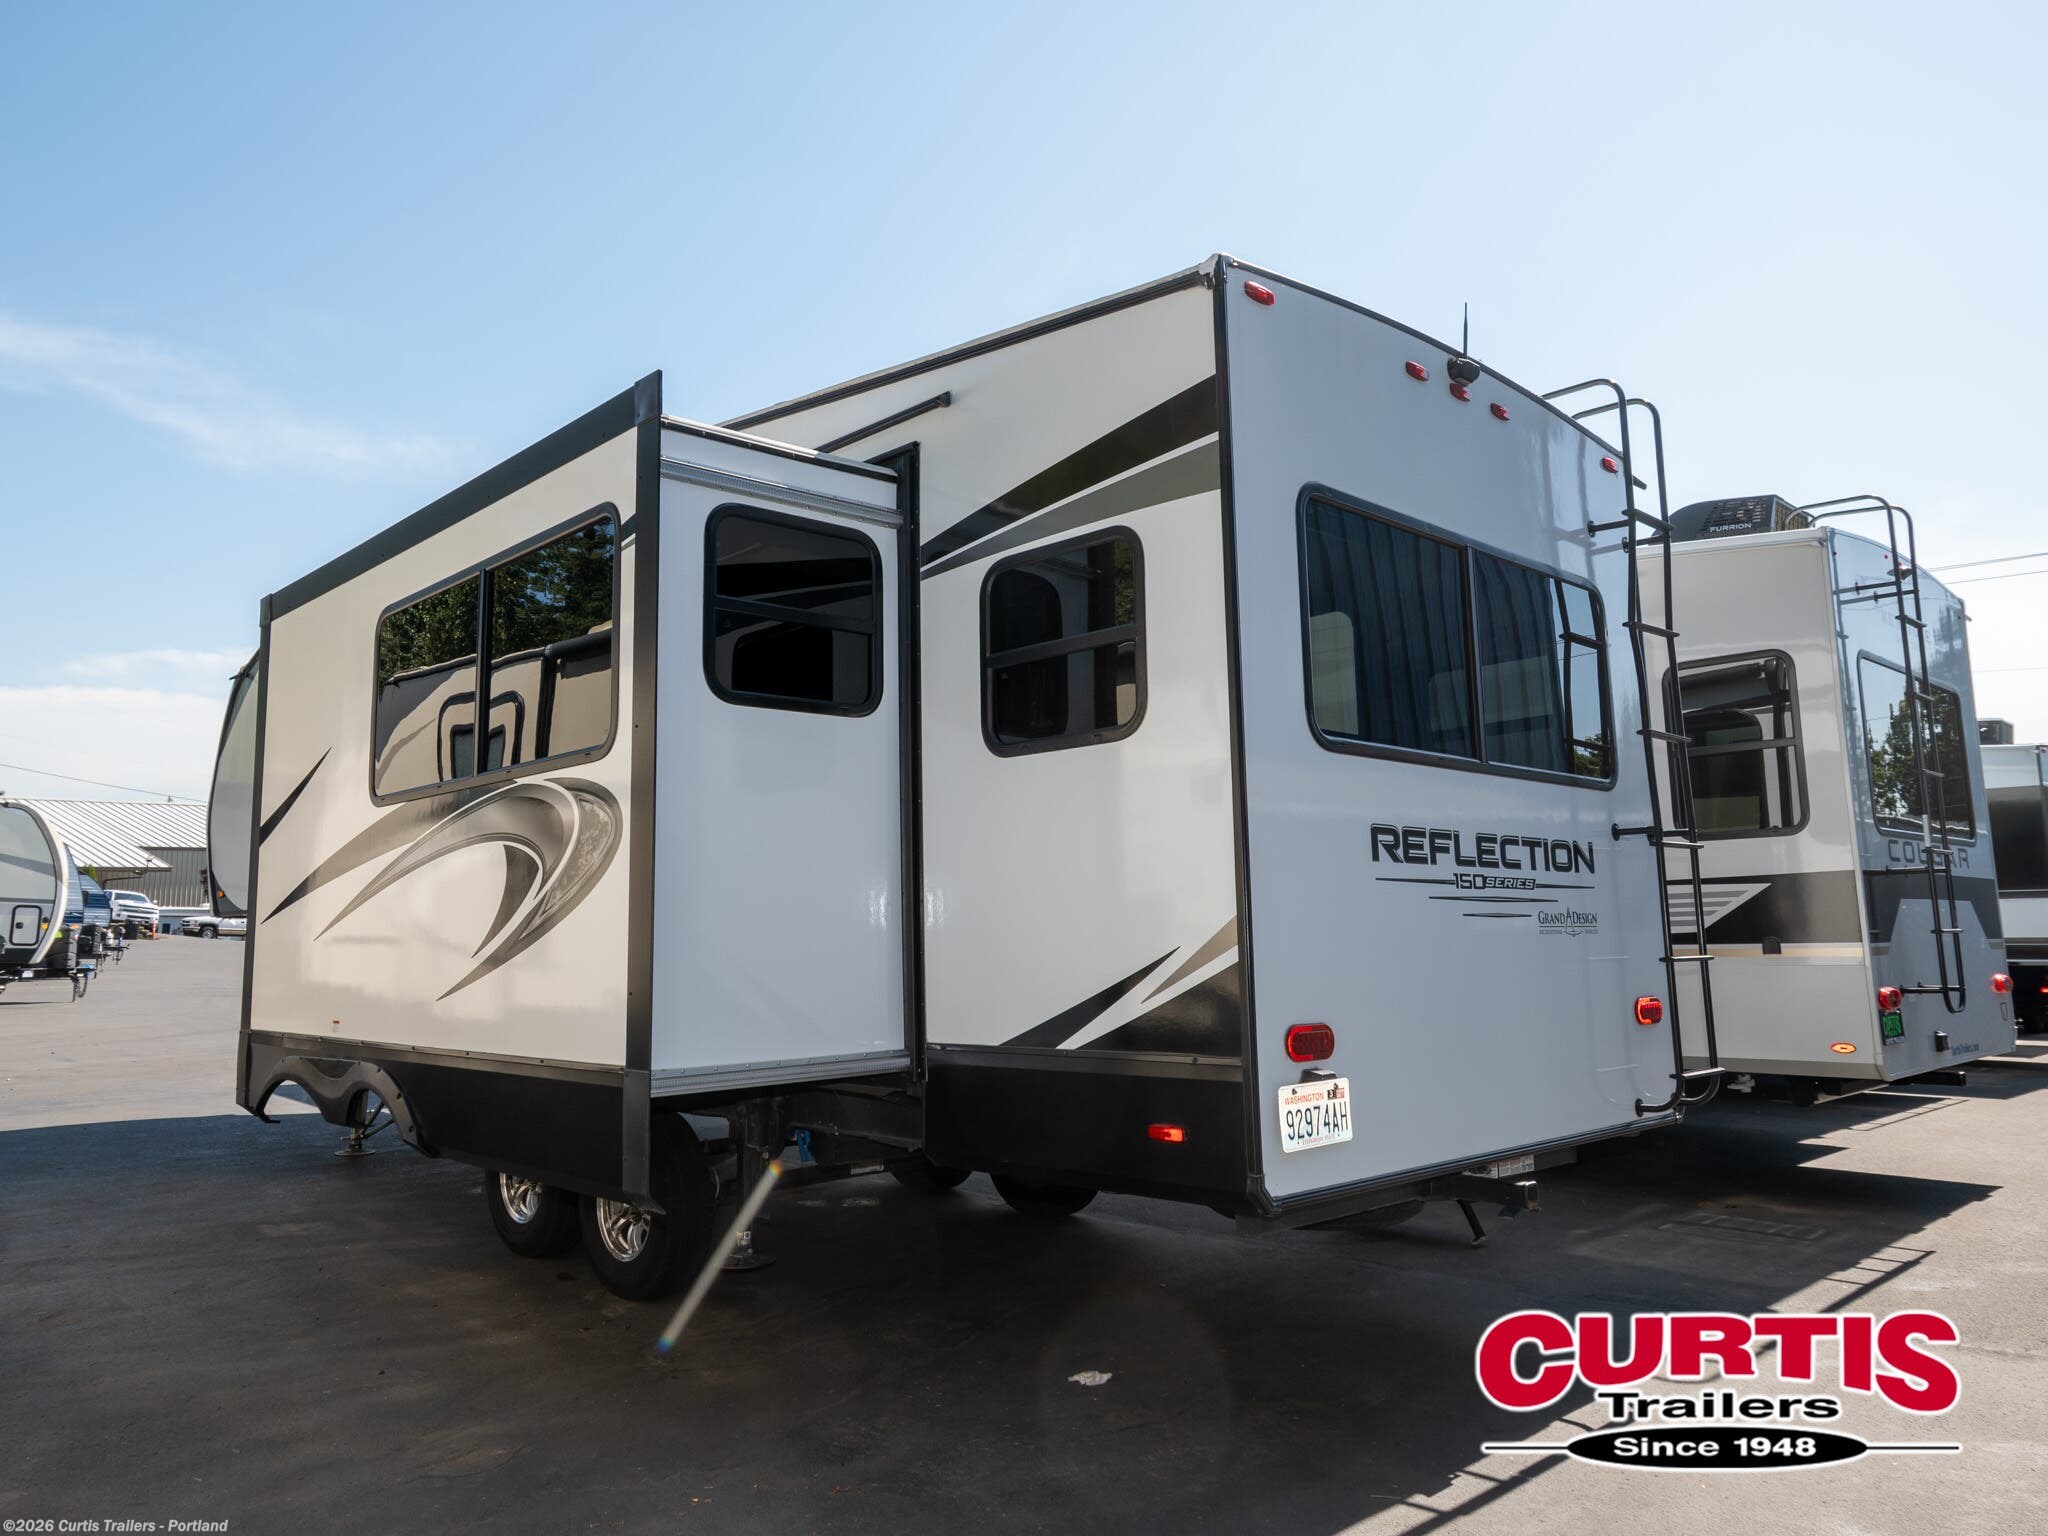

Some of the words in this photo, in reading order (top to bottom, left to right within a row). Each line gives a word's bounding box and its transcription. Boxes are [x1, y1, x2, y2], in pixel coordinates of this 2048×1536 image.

[1710, 523, 1752, 532] FURRION
[1370, 823, 1596, 875] REFLECTION
[1453, 872, 1486, 889] 150
[1485, 876, 1535, 889] SERIES
[1284, 1092, 1325, 1105] WASHINGTON
[1286, 1101, 1349, 1141] 92974AH
